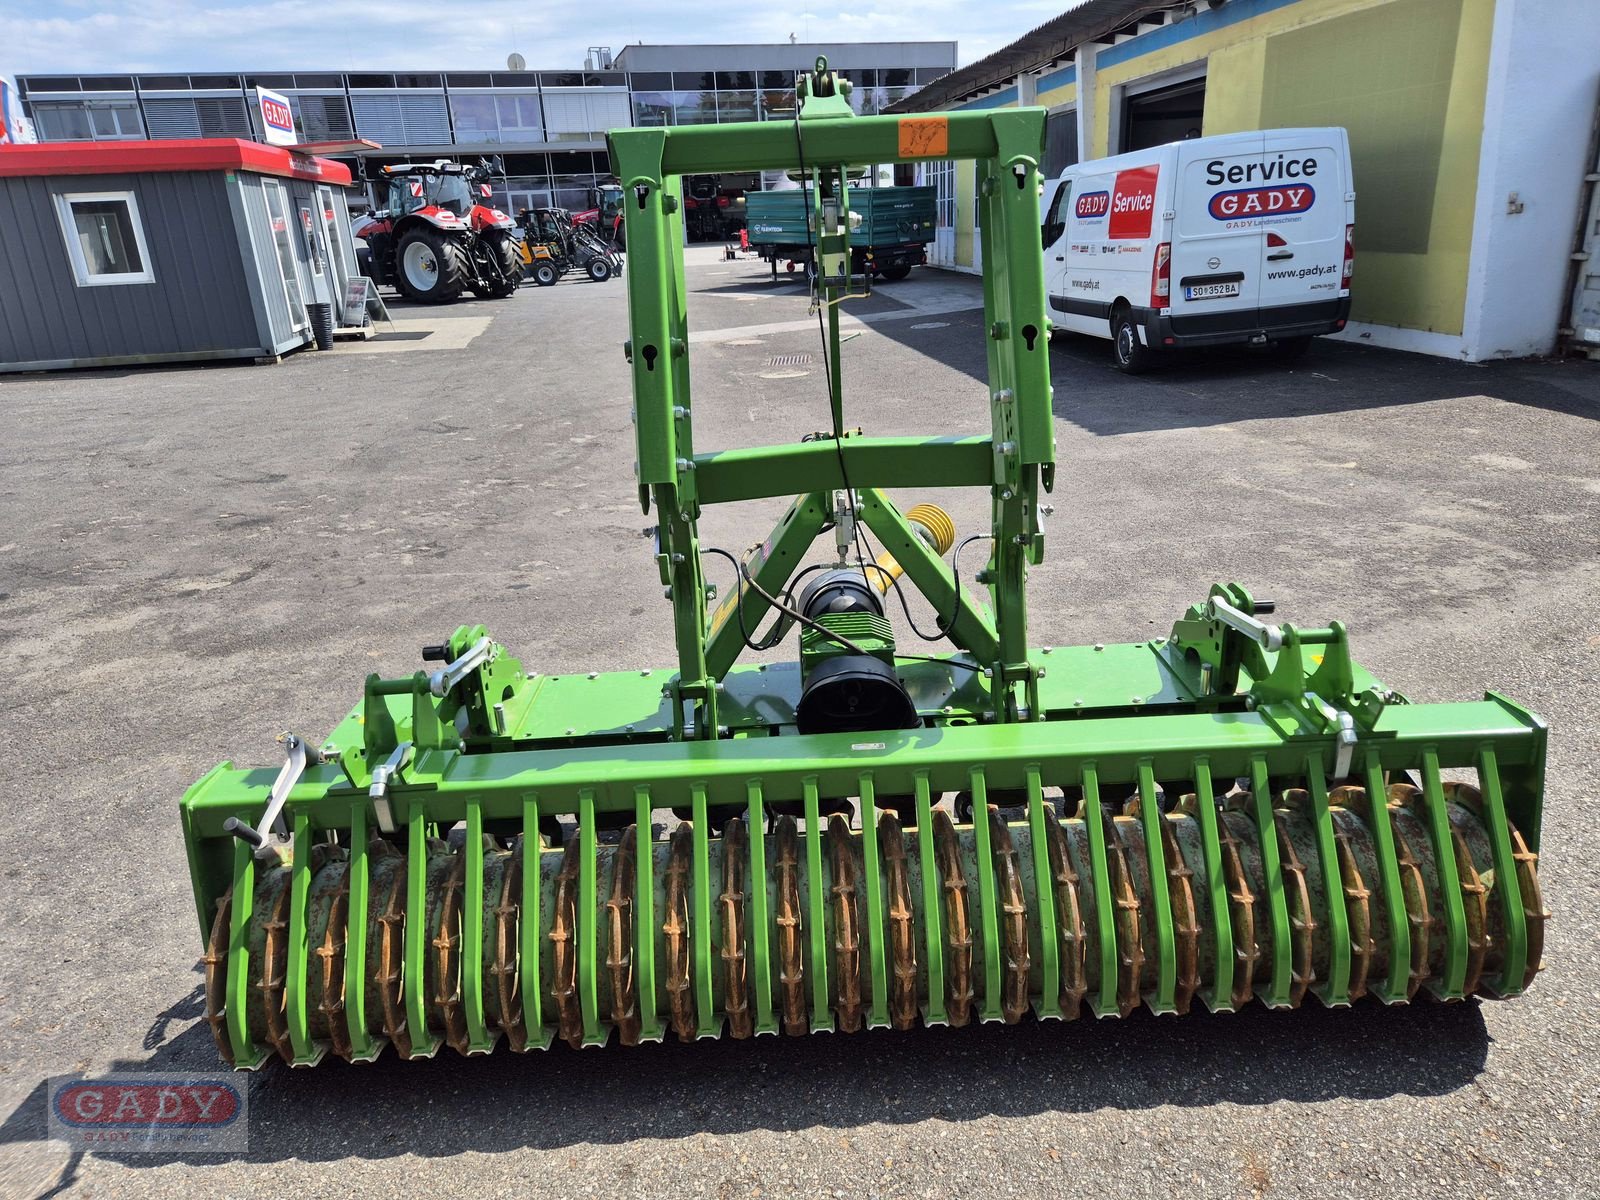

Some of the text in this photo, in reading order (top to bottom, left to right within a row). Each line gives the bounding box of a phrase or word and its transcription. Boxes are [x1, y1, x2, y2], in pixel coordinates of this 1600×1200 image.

[265, 102, 290, 127] GADY
[1206, 154, 1318, 186] Service
[1078, 195, 1107, 214] GADY
[1113, 189, 1152, 213] Service
[1220, 189, 1305, 215] GADY
[1225, 220, 1253, 229] GADY
[1267, 264, 1337, 280] www.gady.at
[1071, 279, 1100, 291] www.gady.at
